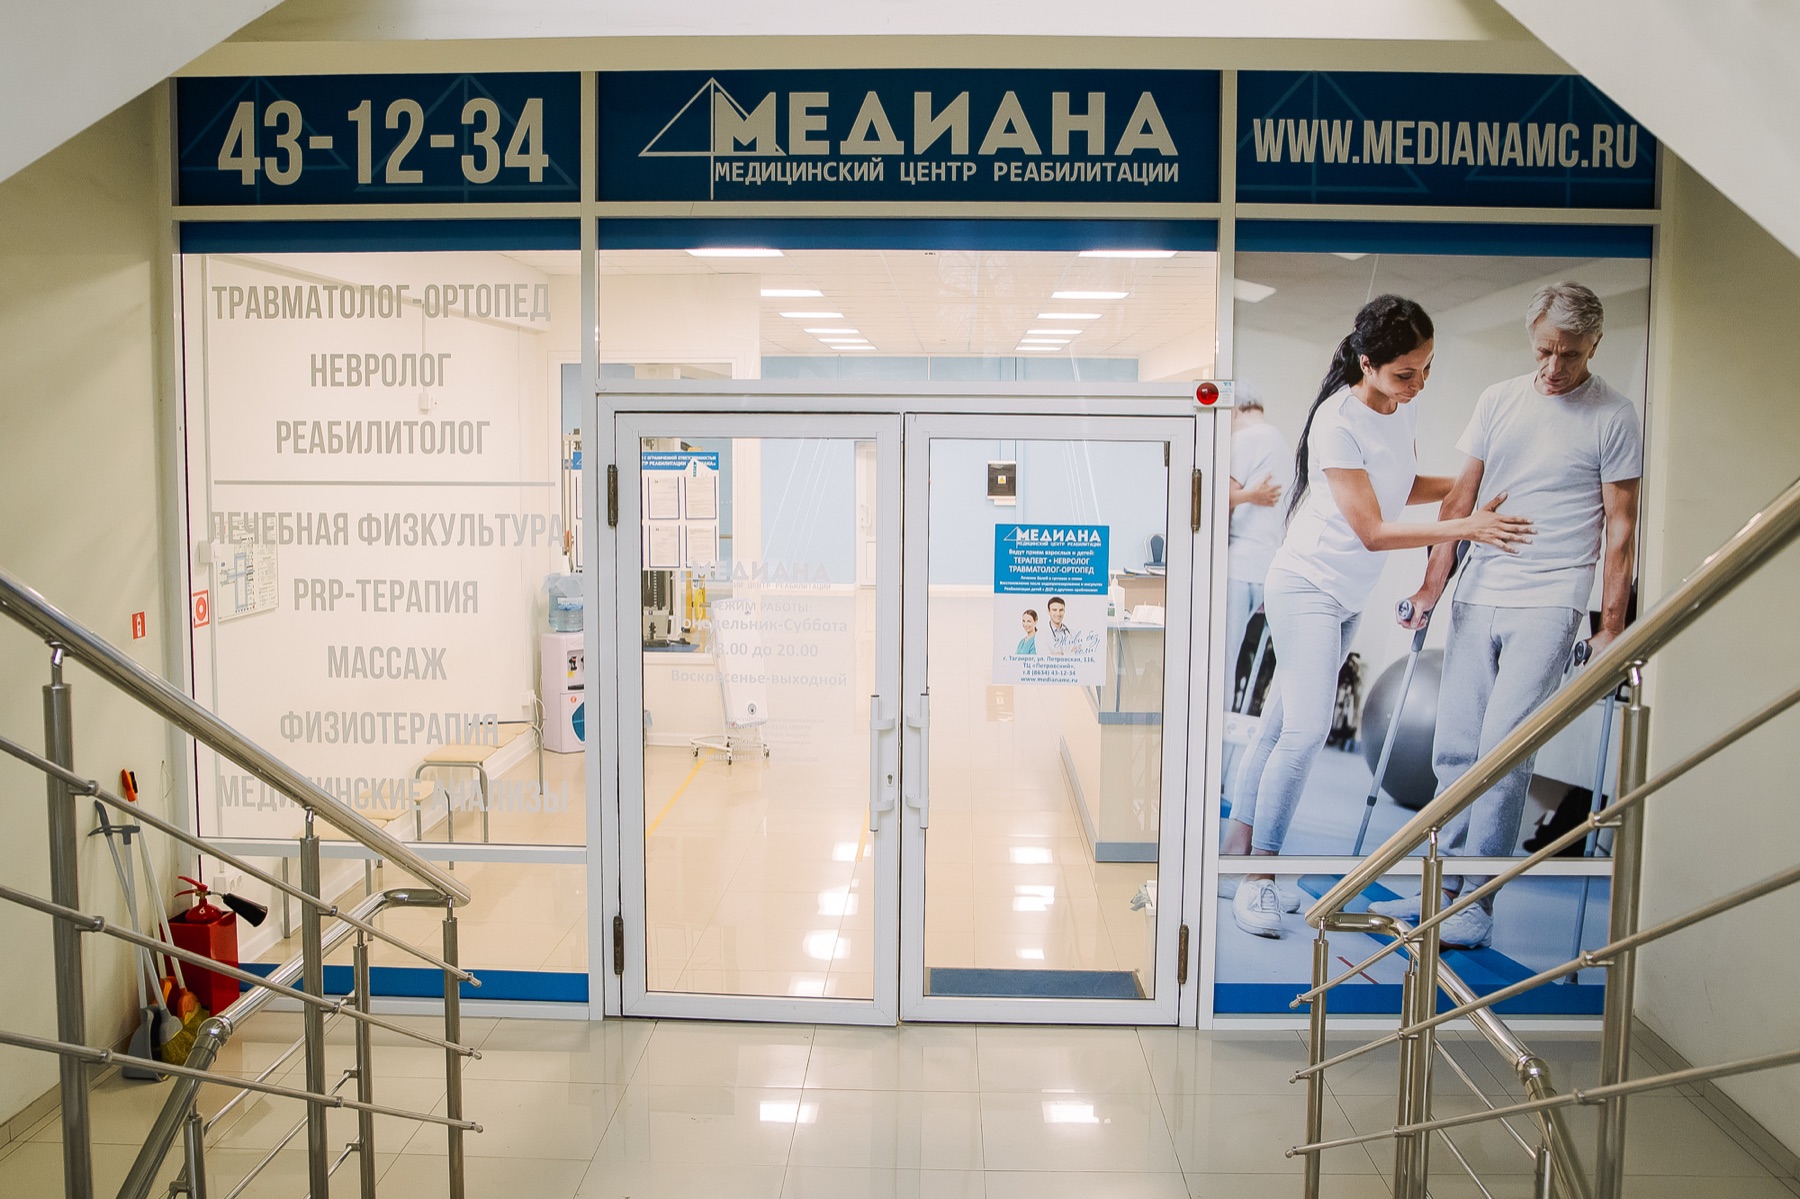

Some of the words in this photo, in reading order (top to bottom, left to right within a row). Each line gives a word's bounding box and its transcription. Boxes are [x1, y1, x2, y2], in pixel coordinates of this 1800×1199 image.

[218, 97, 549, 185] 43-12-34
[714, 91, 1179, 156] МЕДИАНА
[1253, 118, 1638, 169] WWW.MEDIANAMC.RU
[715, 157, 884, 185] МЕДИЦИНСКИЙ
[900, 161, 978, 185] ЦЕНТР
[993, 162, 1180, 184] РЕАБИЛИТАЦИИ
[212, 284, 551, 321] ТРАВМАТОЛОГ-ОРТОПЕД
[310, 353, 451, 387] НЕВРОЛОГ
[276, 420, 490, 455] РЕАБИЛИТОЛОГ
[207, 511, 349, 546] ЛЕЧЕБНАЯ
[358, 513, 564, 547] ФИЗКУЛЬТУРА
[1017, 529, 1102, 542] МЕДИАНА
[692, 560, 831, 582] МЕДИАНА
[1009, 565, 1095, 575] ТРАВМАТОЛОГ-ОРТОПЕД
[1014, 557, 1047, 565] ТЕРАПЕВТ
[1053, 558, 1090, 566] НЕВРОЛОГ
[293, 578, 478, 614] PRP-ТЕРАПИЯ
[712, 601, 756, 613] ЕЖИМ
[327, 646, 447, 681] МАССАЖ
[751, 646, 772, 659] до
[776, 643, 819, 657] 20.00
[670, 669, 848, 688] Воскресенье-выходной
[280, 711, 499, 746] ФИЗИОТЕРАПИЯ
[219, 775, 423, 812] МЕДНСКИЕ
[431, 778, 568, 814] АНАЛИЗЫ
